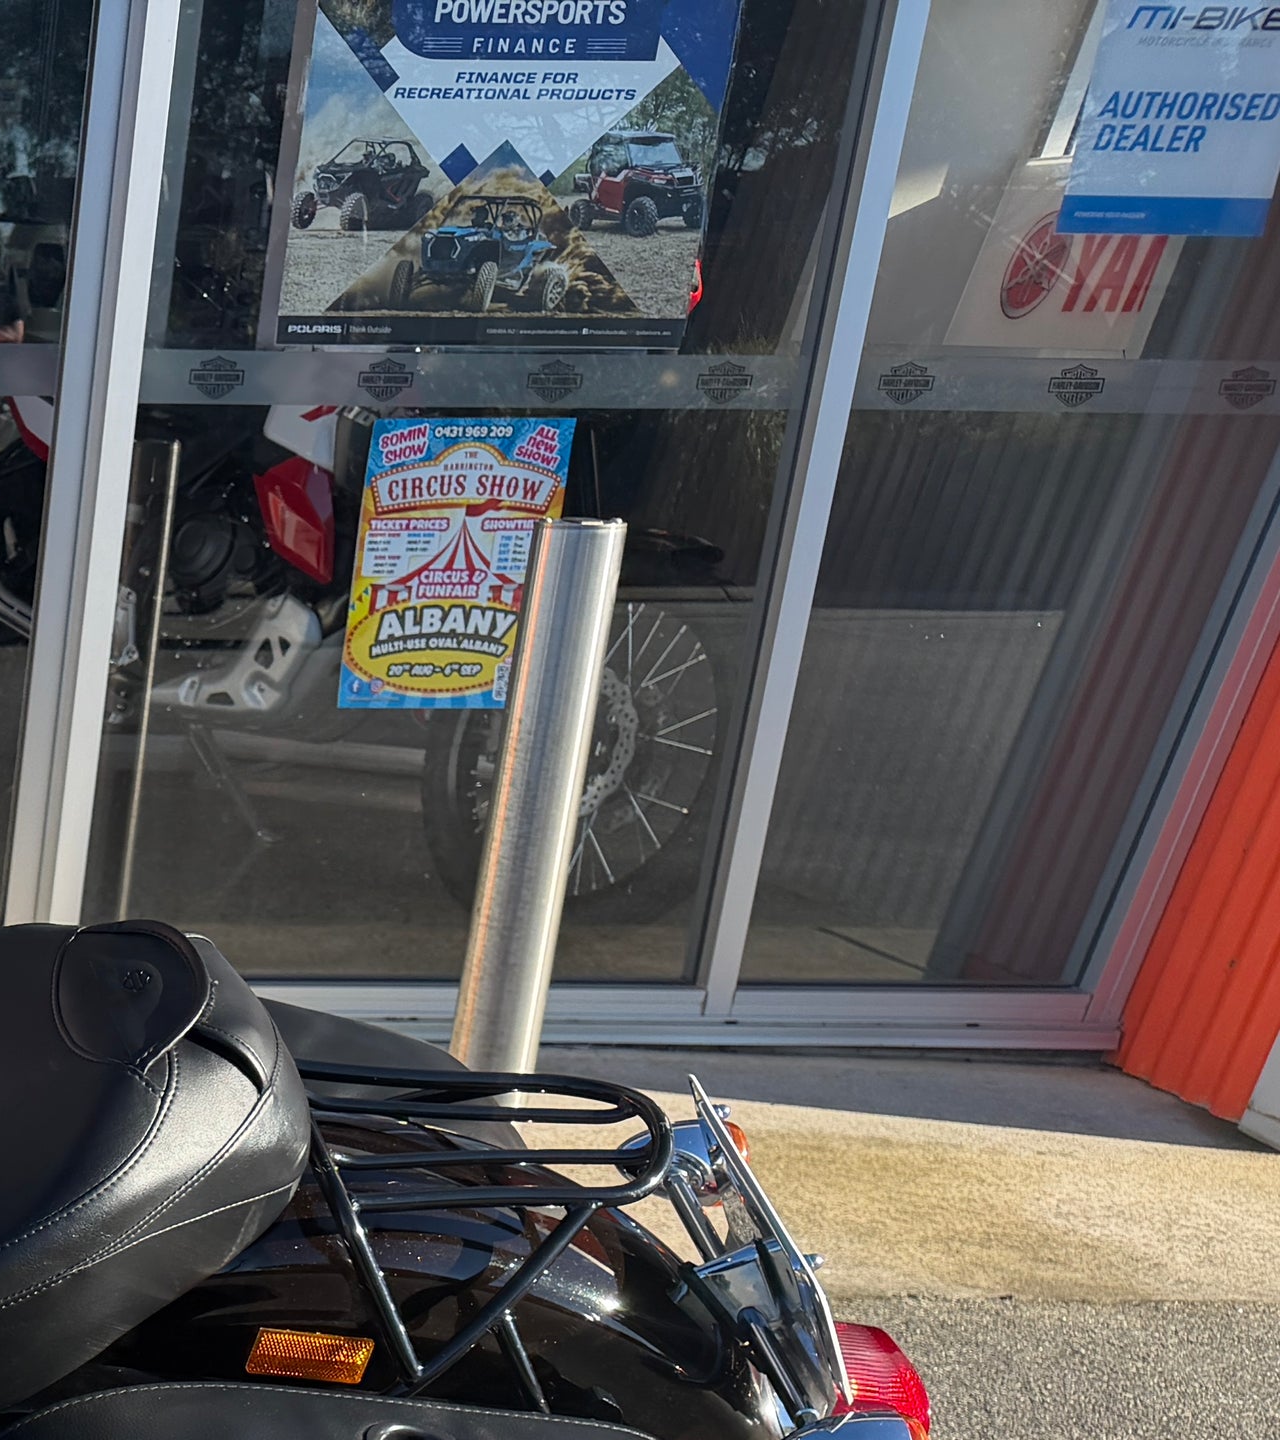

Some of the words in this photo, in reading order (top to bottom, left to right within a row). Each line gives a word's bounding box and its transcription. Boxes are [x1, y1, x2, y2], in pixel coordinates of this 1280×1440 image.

[433, 0, 627, 25] POWERSPORTS
[471, 37, 577, 54] FINANCE
[455, 72, 538, 85] FINANCE
[541, 72, 579, 84] FOR
[393, 87, 532, 100] RECREATIONAL
[537, 88, 637, 101] PRODUCTS
[1096, 91, 1280, 121] AUTHORISED
[1092, 124, 1206, 153] DEALER
[287, 324, 342, 334] POLARIS
[434, 426, 463, 437] 0431
[464, 426, 488, 437] 969
[489, 426, 514, 437] 209
[535, 426, 558, 442] ALL
[384, 440, 427, 464] SHOW
[464, 451, 478, 459] THE
[515, 445, 559, 468] SHOW!
[387, 474, 467, 502] CIRCUS
[476, 473, 545, 502] SHOW
[370, 519, 409, 530] TICKET
[410, 519, 449, 529] PRICES
[419, 570, 469, 584] CIRCUS
[417, 585, 478, 598] FUNFAIR
[377, 606, 518, 641] ALBANY
[371, 637, 427, 657] MULTI-USE
[428, 637, 459, 649] OVAL
[460, 638, 506, 654] ALBANY
[411, 664, 434, 676] AUG
[460, 664, 481, 676] SEP
